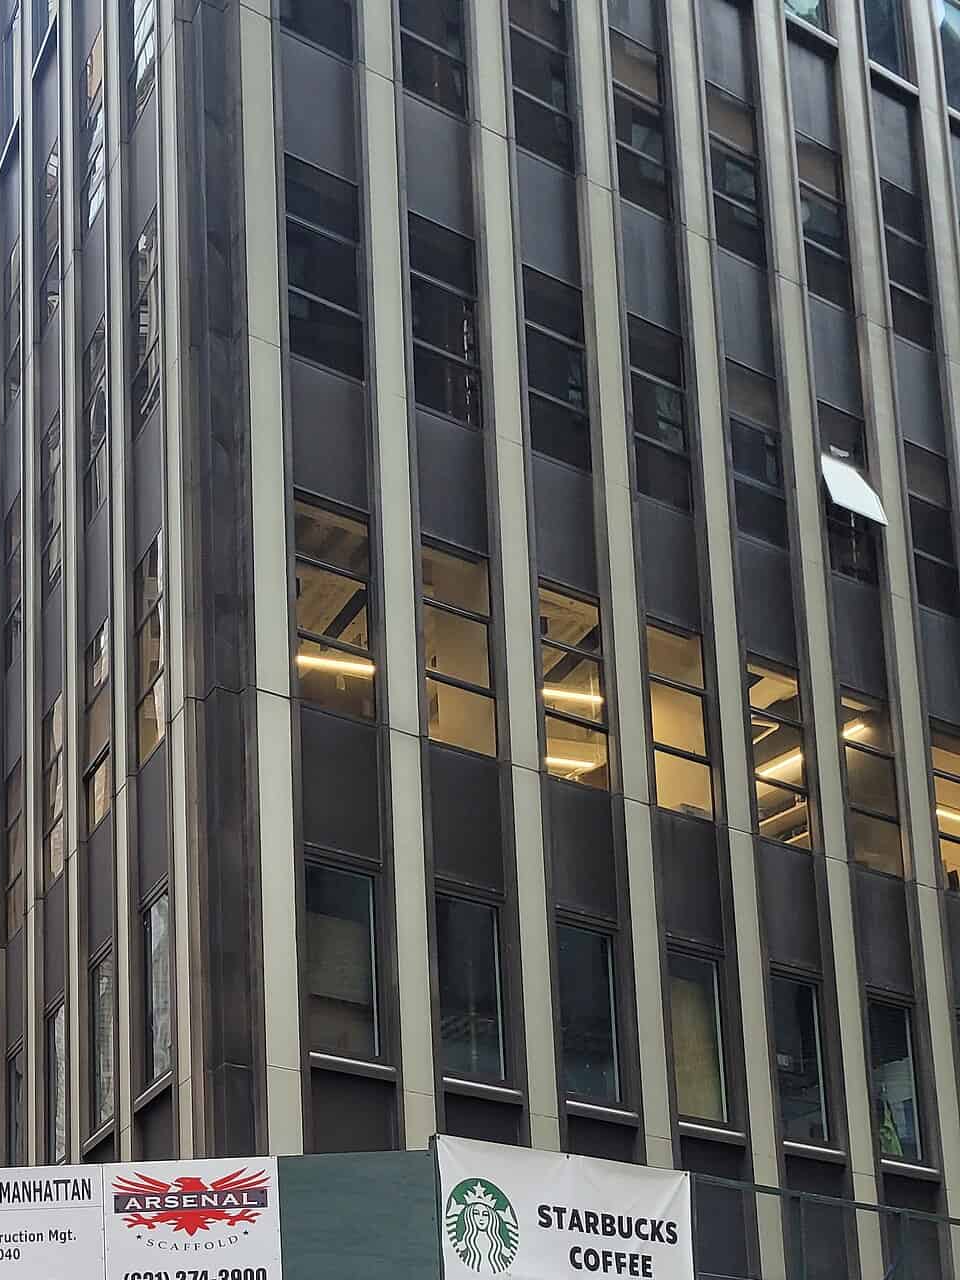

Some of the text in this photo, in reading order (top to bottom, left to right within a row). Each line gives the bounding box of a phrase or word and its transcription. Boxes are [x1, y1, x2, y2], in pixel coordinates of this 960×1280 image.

[0, 1178, 92, 1204] MANHATTAN
[124, 1193, 257, 1210] ARSENAL
[537, 1204, 678, 1245] STARBUCKS
[49, 1229, 77, 1245] Mgt.
[146, 1235, 239, 1251] SCAFFOLD
[570, 1246, 653, 1278] COFFEE
